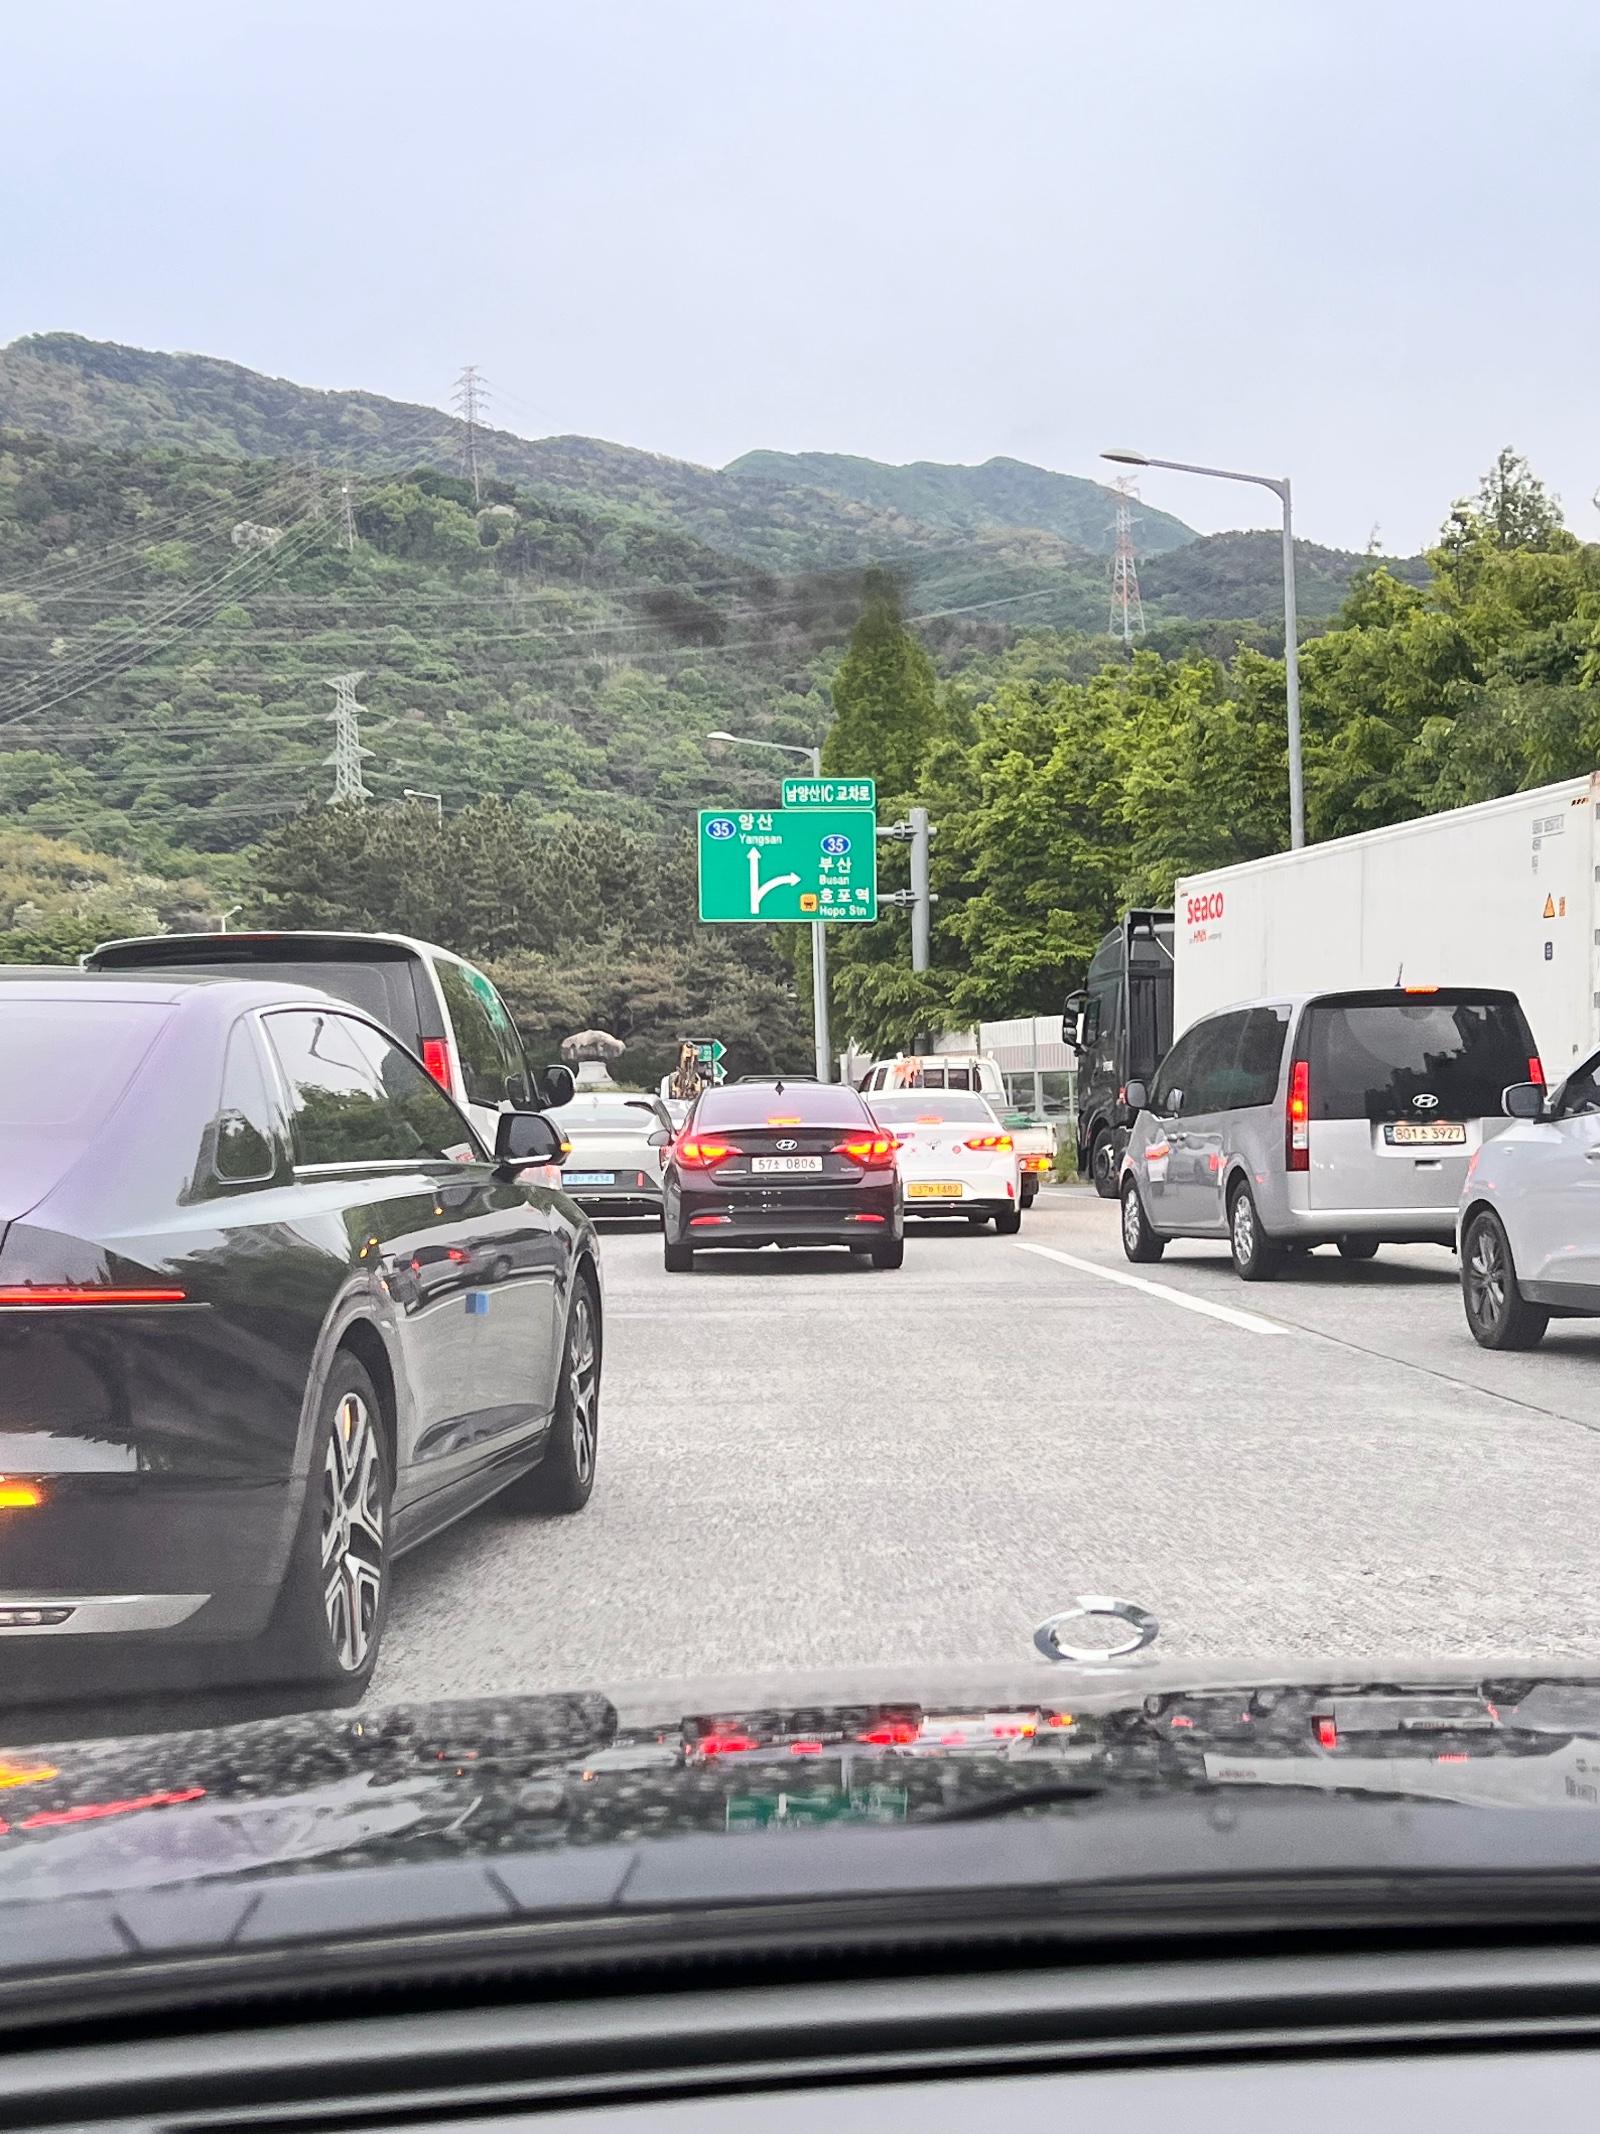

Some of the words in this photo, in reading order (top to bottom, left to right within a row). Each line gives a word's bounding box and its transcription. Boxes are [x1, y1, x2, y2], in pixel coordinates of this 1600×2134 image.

[785, 784, 834, 803] 남양산IC
[836, 784, 871, 802] 교차로
[712, 822, 730, 837] 35
[739, 813, 773, 831] 양산
[739, 833, 783, 846] Yangsan
[827, 837, 844, 852] 35
[818, 856, 852, 874] 부산
[819, 874, 850, 886] Busan
[819, 887, 870, 904] 호포역
[820, 905, 846, 918] Hopo
[1187, 892, 1224, 926] seaco
[1431, 1127, 1461, 1140] 3927
[786, 1158, 816, 1170] 0806
